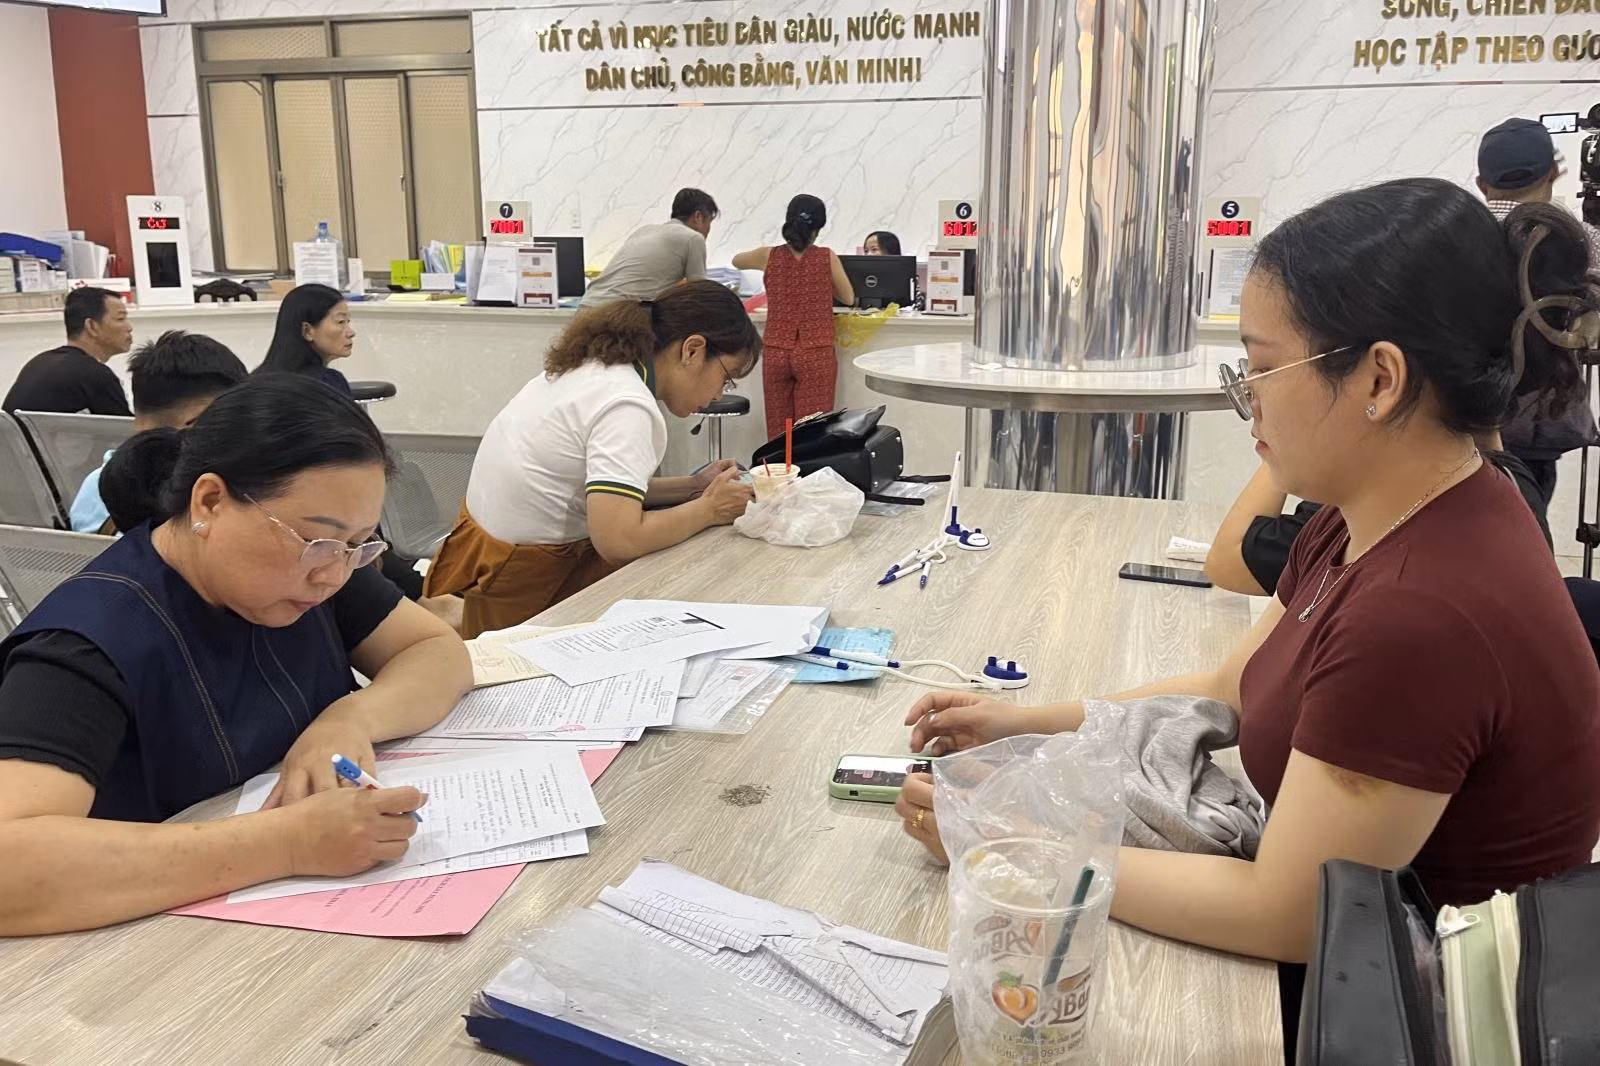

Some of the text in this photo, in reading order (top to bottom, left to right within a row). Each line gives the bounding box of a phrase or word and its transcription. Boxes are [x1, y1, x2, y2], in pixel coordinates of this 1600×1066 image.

[535, 8, 980, 53] TẤT CẢ VÌ MỤC TIÊU DÂN GIÀU, NƯỚC MẠNH
[1353, 39, 1407, 74] HỌC
[1416, 31, 1468, 71] TẬP
[1476, 34, 1545, 65] THEO
[586, 52, 922, 92] DÂN CHỦ, CÔNG BẰNG, VĂN MINH!
[154, 201, 162, 212] 8
[503, 205, 509, 217] 7
[960, 205, 967, 217] 6
[1226, 203, 1235, 216] 5
